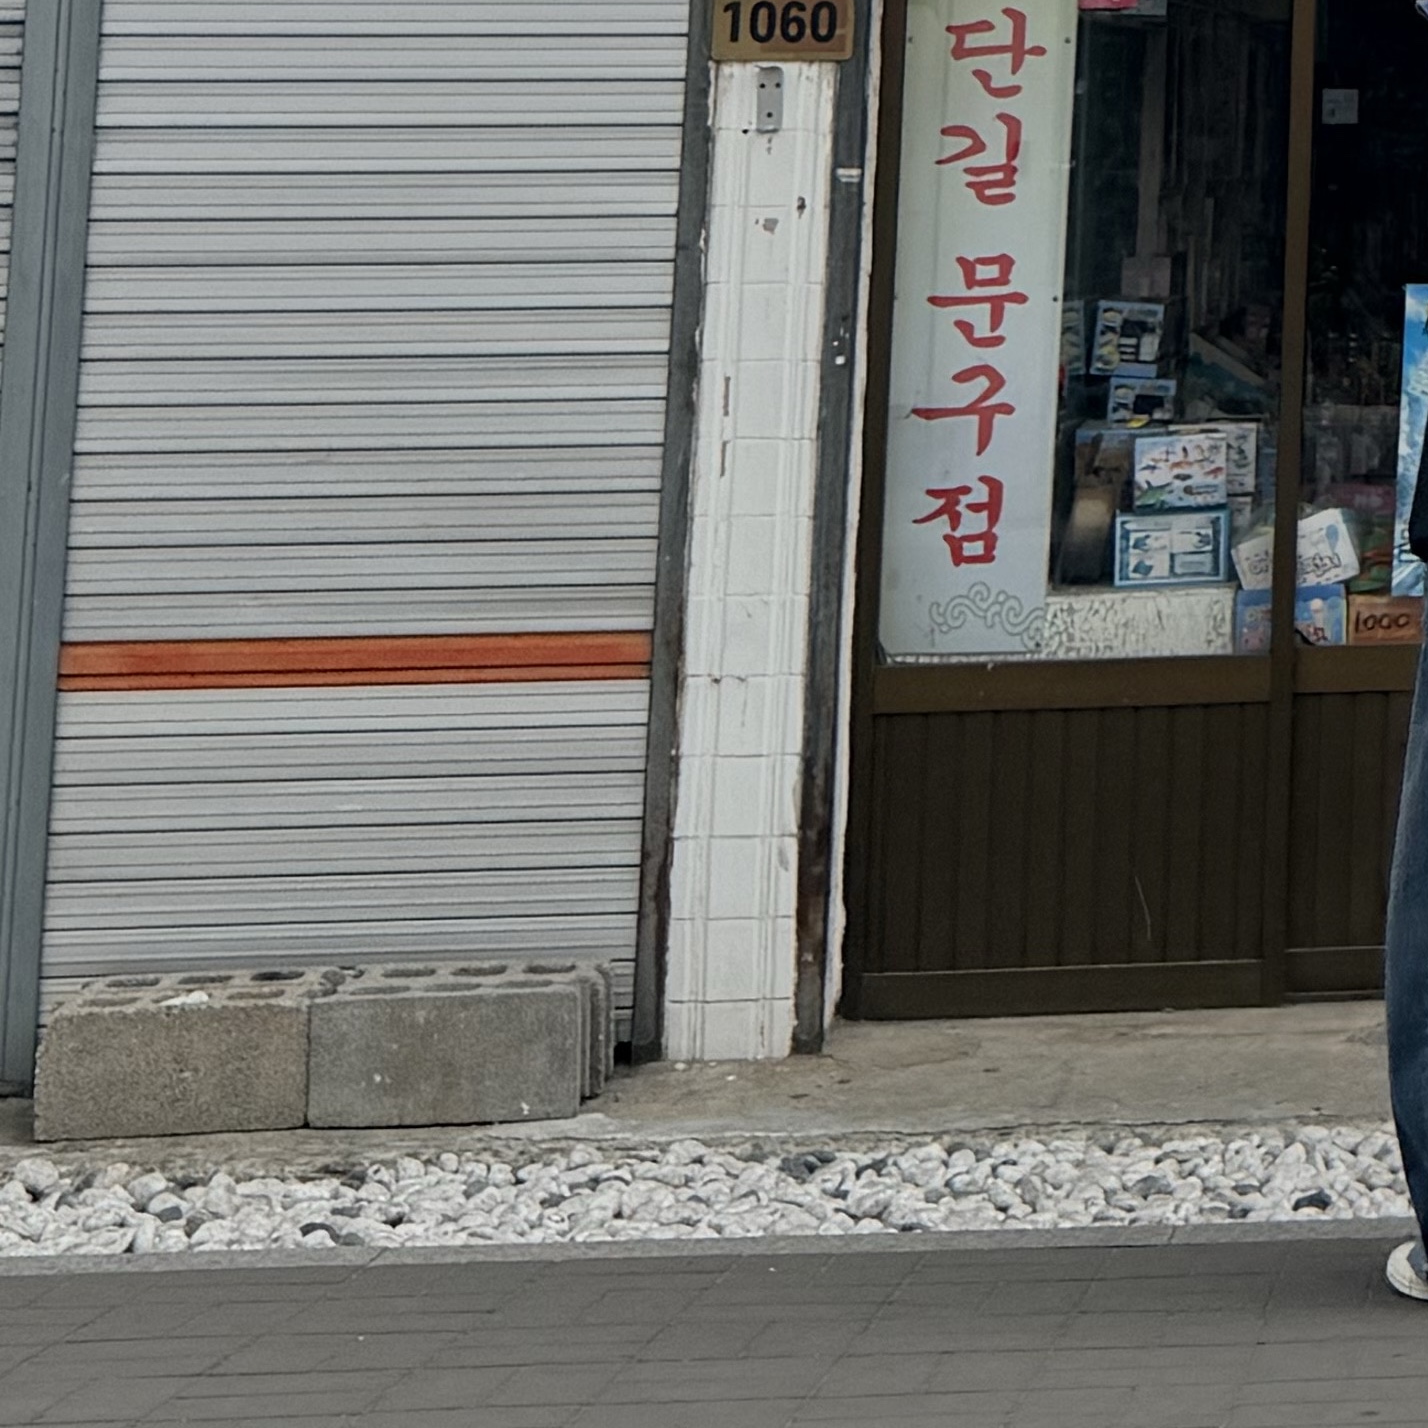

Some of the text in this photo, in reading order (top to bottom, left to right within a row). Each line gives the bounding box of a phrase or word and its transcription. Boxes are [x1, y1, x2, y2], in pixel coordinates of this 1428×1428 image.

[722, 0, 838, 44] 1060
[911, 252, 1029, 567] 문구점
[1354, 612, 1411, 634] 1000
